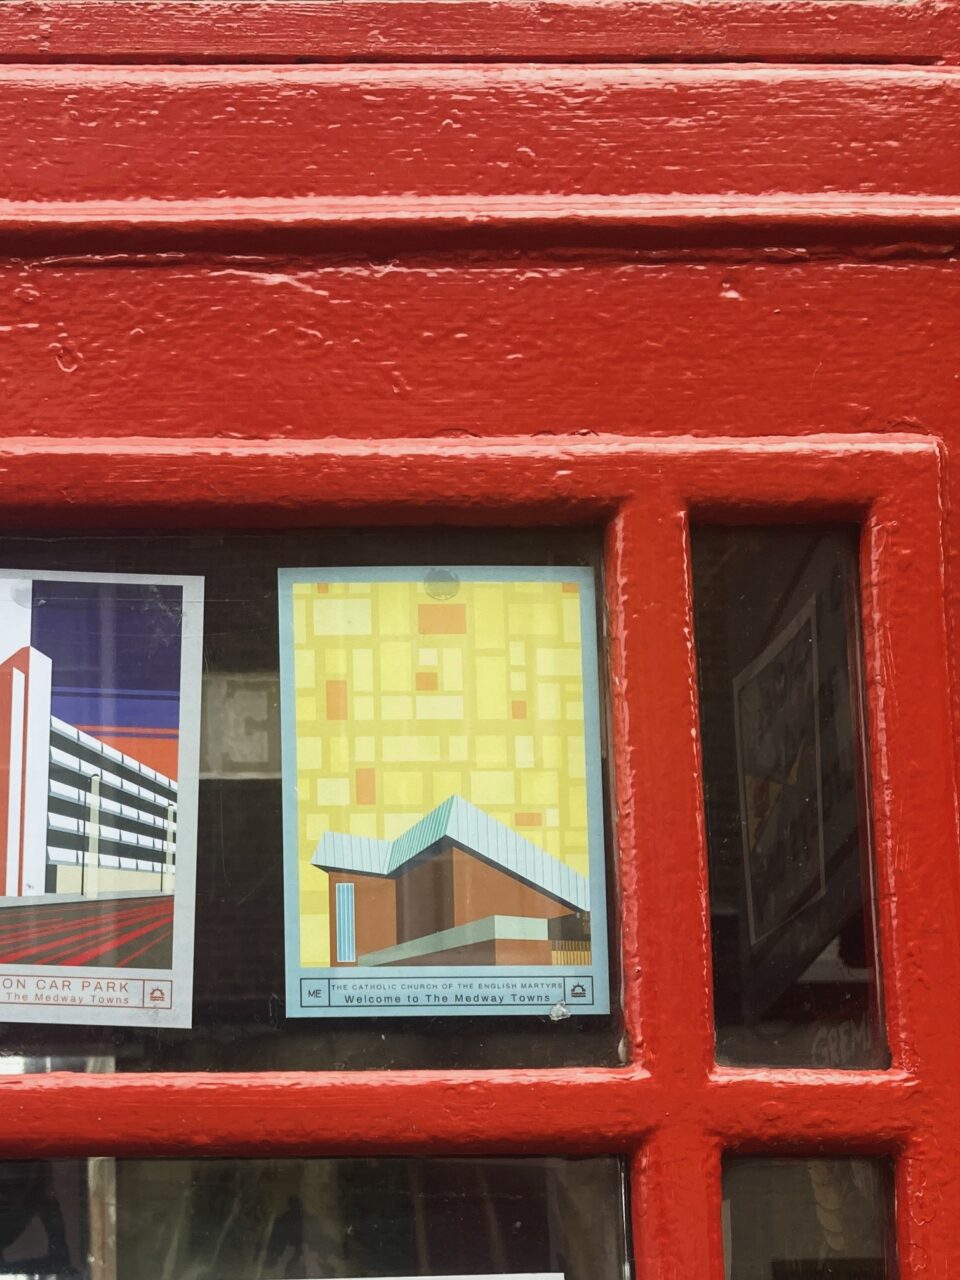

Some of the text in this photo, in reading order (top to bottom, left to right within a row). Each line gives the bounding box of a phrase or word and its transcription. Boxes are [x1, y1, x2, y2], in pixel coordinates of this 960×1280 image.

[36, 979, 73, 991] CAR
[81, 981, 130, 993] PARK
[7, 992, 28, 1001] The
[35, 993, 84, 1004] Medway
[91, 995, 130, 1004] Towns
[308, 989, 322, 998] ME
[344, 993, 550, 1004] Welcome to The Medway Towns
